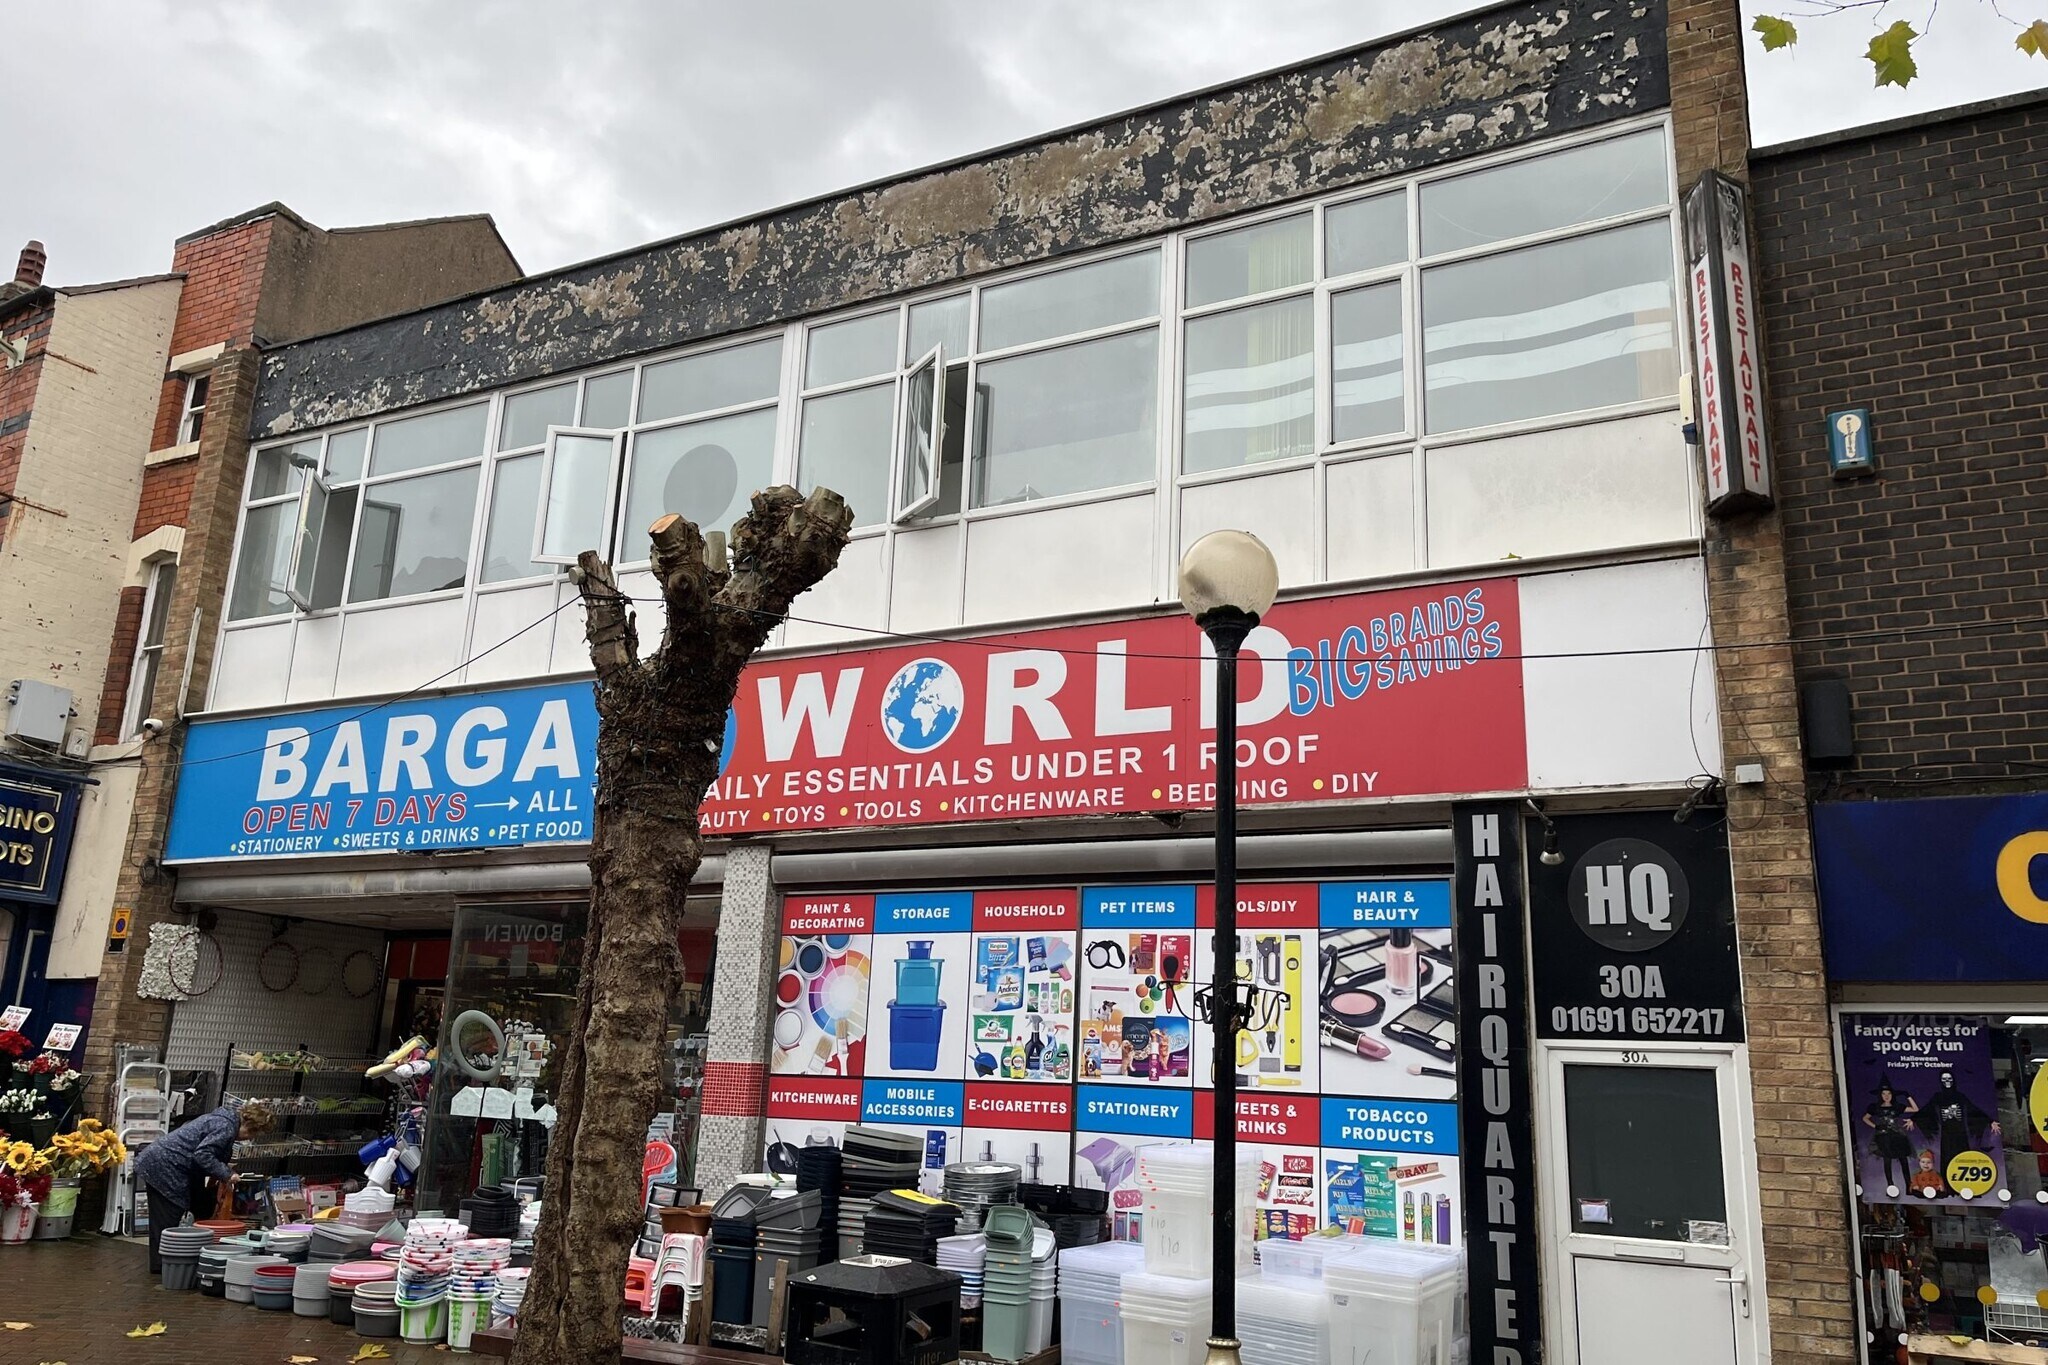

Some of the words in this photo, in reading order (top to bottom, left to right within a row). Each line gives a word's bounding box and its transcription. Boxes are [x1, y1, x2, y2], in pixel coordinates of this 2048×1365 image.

[1695, 269, 1721, 489] RESTAURANT
[1731, 262, 1763, 483] RESTAURANT
[1370, 587, 1485, 652] BRANDS
[1375, 620, 1502, 690] SAVINGS
[1286, 625, 1373, 717] BIG
[256, 699, 581, 801] BARGA
[527, 788, 578, 814] ALL
[703, 773, 771, 802] AILY
[783, 757, 994, 796] ESSENTIALS
[1011, 746, 1143, 782] UNDER
[1162, 743, 1176, 771] 1
[1200, 734, 1319, 770] ROOF
[700, 809, 751, 829] AUTY
[774, 805, 825, 824] TOYS
[855, 799, 922, 820] TOOLS
[953, 787, 1124, 814] KITCHENWARE
[1169, 778, 1288, 803] BEDING
[1332, 771, 1379, 795] DIY
[243, 802, 331, 835] OPEN
[346, 800, 363, 828] 7
[375, 792, 467, 826] DAYS
[237, 835, 323, 855] STATIONERY
[341, 831, 400, 849] SWEETS
[405, 829, 415, 846] &
[421, 827, 480, 843] DRINKS
[498, 823, 530, 840] PET
[535, 820, 583, 838] FOOD
[1357, 891, 1397, 903] HAIR
[1404, 891, 1415, 903] &
[1585, 863, 1672, 931] HQ
[805, 904, 838, 914] PAINT
[843, 903, 852, 913] &
[893, 907, 950, 920] STORAGE
[984, 904, 1066, 917] HOUSEHOLD
[1100, 902, 1126, 914] PET
[1131, 902, 1175, 914] ITEMS
[1236, 900, 1297, 913] OLS/DIY
[1353, 909, 1420, 921] BEAUTY
[790, 917, 865, 929] DECORATING
[1599, 965, 1666, 998] 30A
[1551, 1006, 1626, 1033] 01691
[1631, 1007, 1725, 1035] 652217
[1854, 1025, 1901, 1039] Fancy
[1905, 1024, 1950, 1036] dress
[1954, 1024, 1979, 1036] for
[1873, 1039, 1931, 1054] spooky
[1936, 1039, 1963, 1051] fun
[1621, 1050, 1649, 1064] 30A
[771, 1091, 858, 1106] KITCHENWARE
[887, 1088, 935, 1100] MOBILE
[866, 1103, 955, 1118] ACCESSORIES
[968, 1099, 1067, 1114] E-CIGARETTES
[1088, 1101, 1180, 1118] STATIONERY
[1235, 1102, 1279, 1116] EETS
[1286, 1105, 1297, 1117] &
[1347, 1108, 1428, 1125] TOBACCO
[1238, 1120, 1287, 1135] RINKS
[1342, 1127, 1434, 1144] PRODUCTS
[1404, 1164, 1429, 1178] RAW
[1951, 1166, 1993, 1182] £7.99
